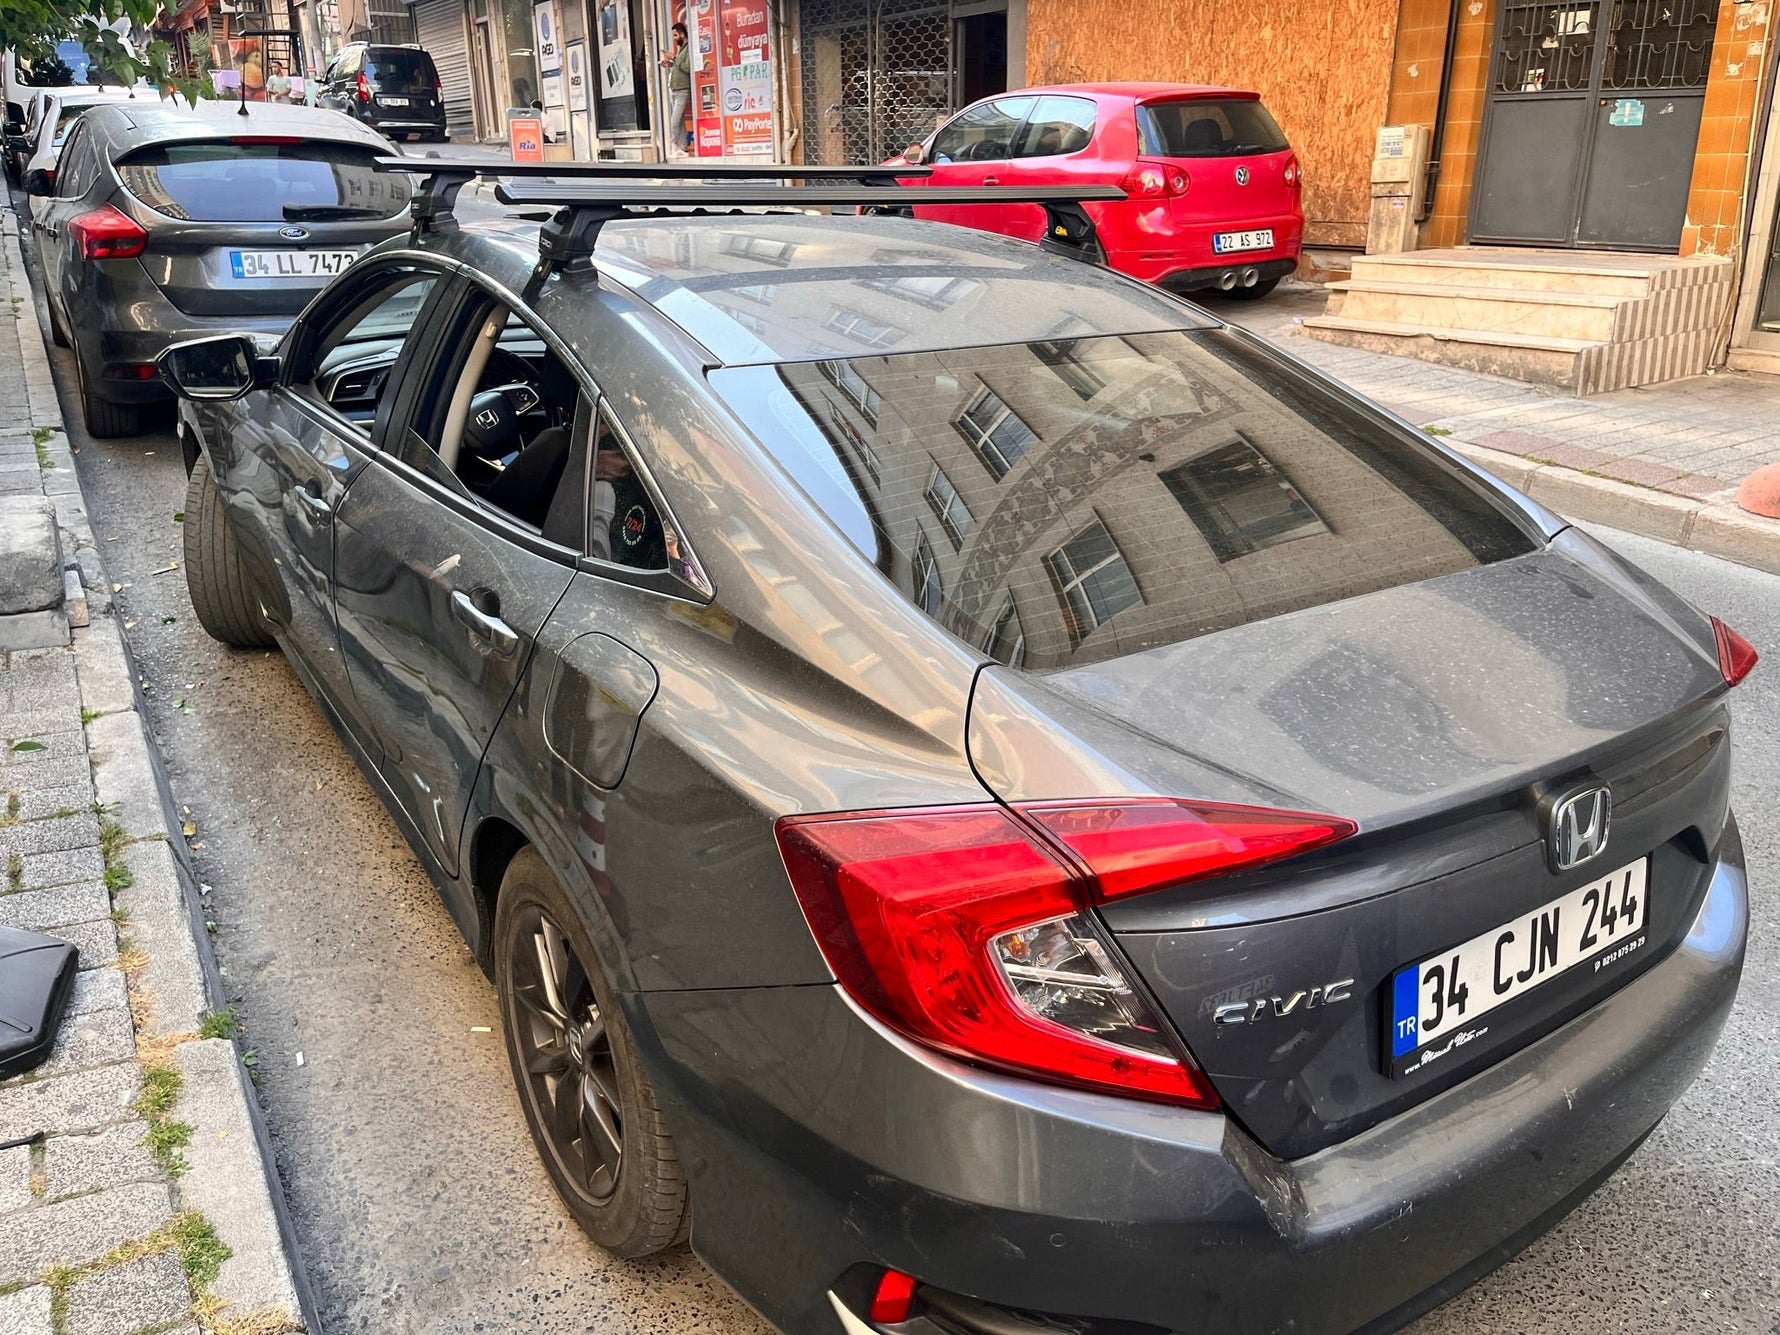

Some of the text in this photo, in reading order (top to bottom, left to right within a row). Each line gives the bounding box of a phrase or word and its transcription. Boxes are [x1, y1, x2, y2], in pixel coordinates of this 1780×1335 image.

[736, 10, 764, 28] Buradan
[738, 33, 768, 49] dünyaya
[519, 139, 537, 151] Ria
[286, 229, 302, 237] Ford
[1222, 232, 1271, 249] 22 AS 972
[243, 254, 269, 275] 34
[277, 254, 302, 274] LL
[1397, 870, 1638, 1039] TR 34 CJN 244
[1212, 978, 1355, 1025] CIVIC
